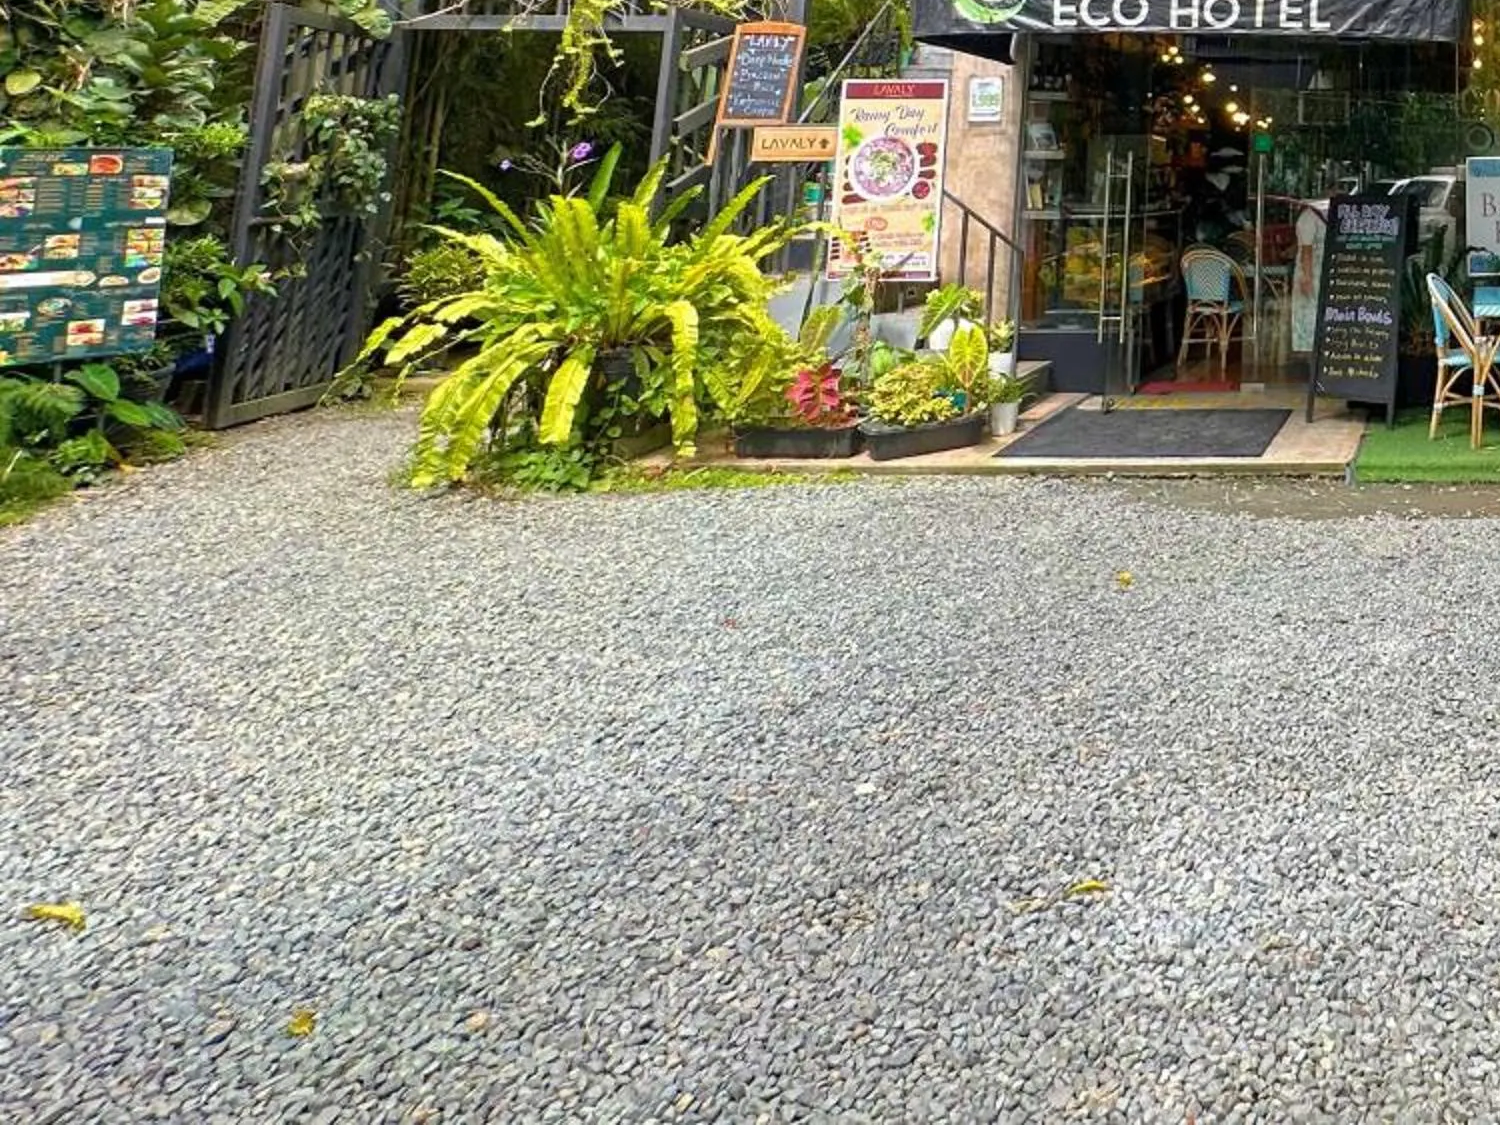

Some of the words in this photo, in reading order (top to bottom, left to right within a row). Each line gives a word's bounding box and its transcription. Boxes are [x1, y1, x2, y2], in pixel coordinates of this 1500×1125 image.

[874, 85, 915, 96] LAVALY
[896, 105, 925, 121] Day
[884, 124, 938, 139] Comfort
[761, 137, 817, 150] LAVALY
